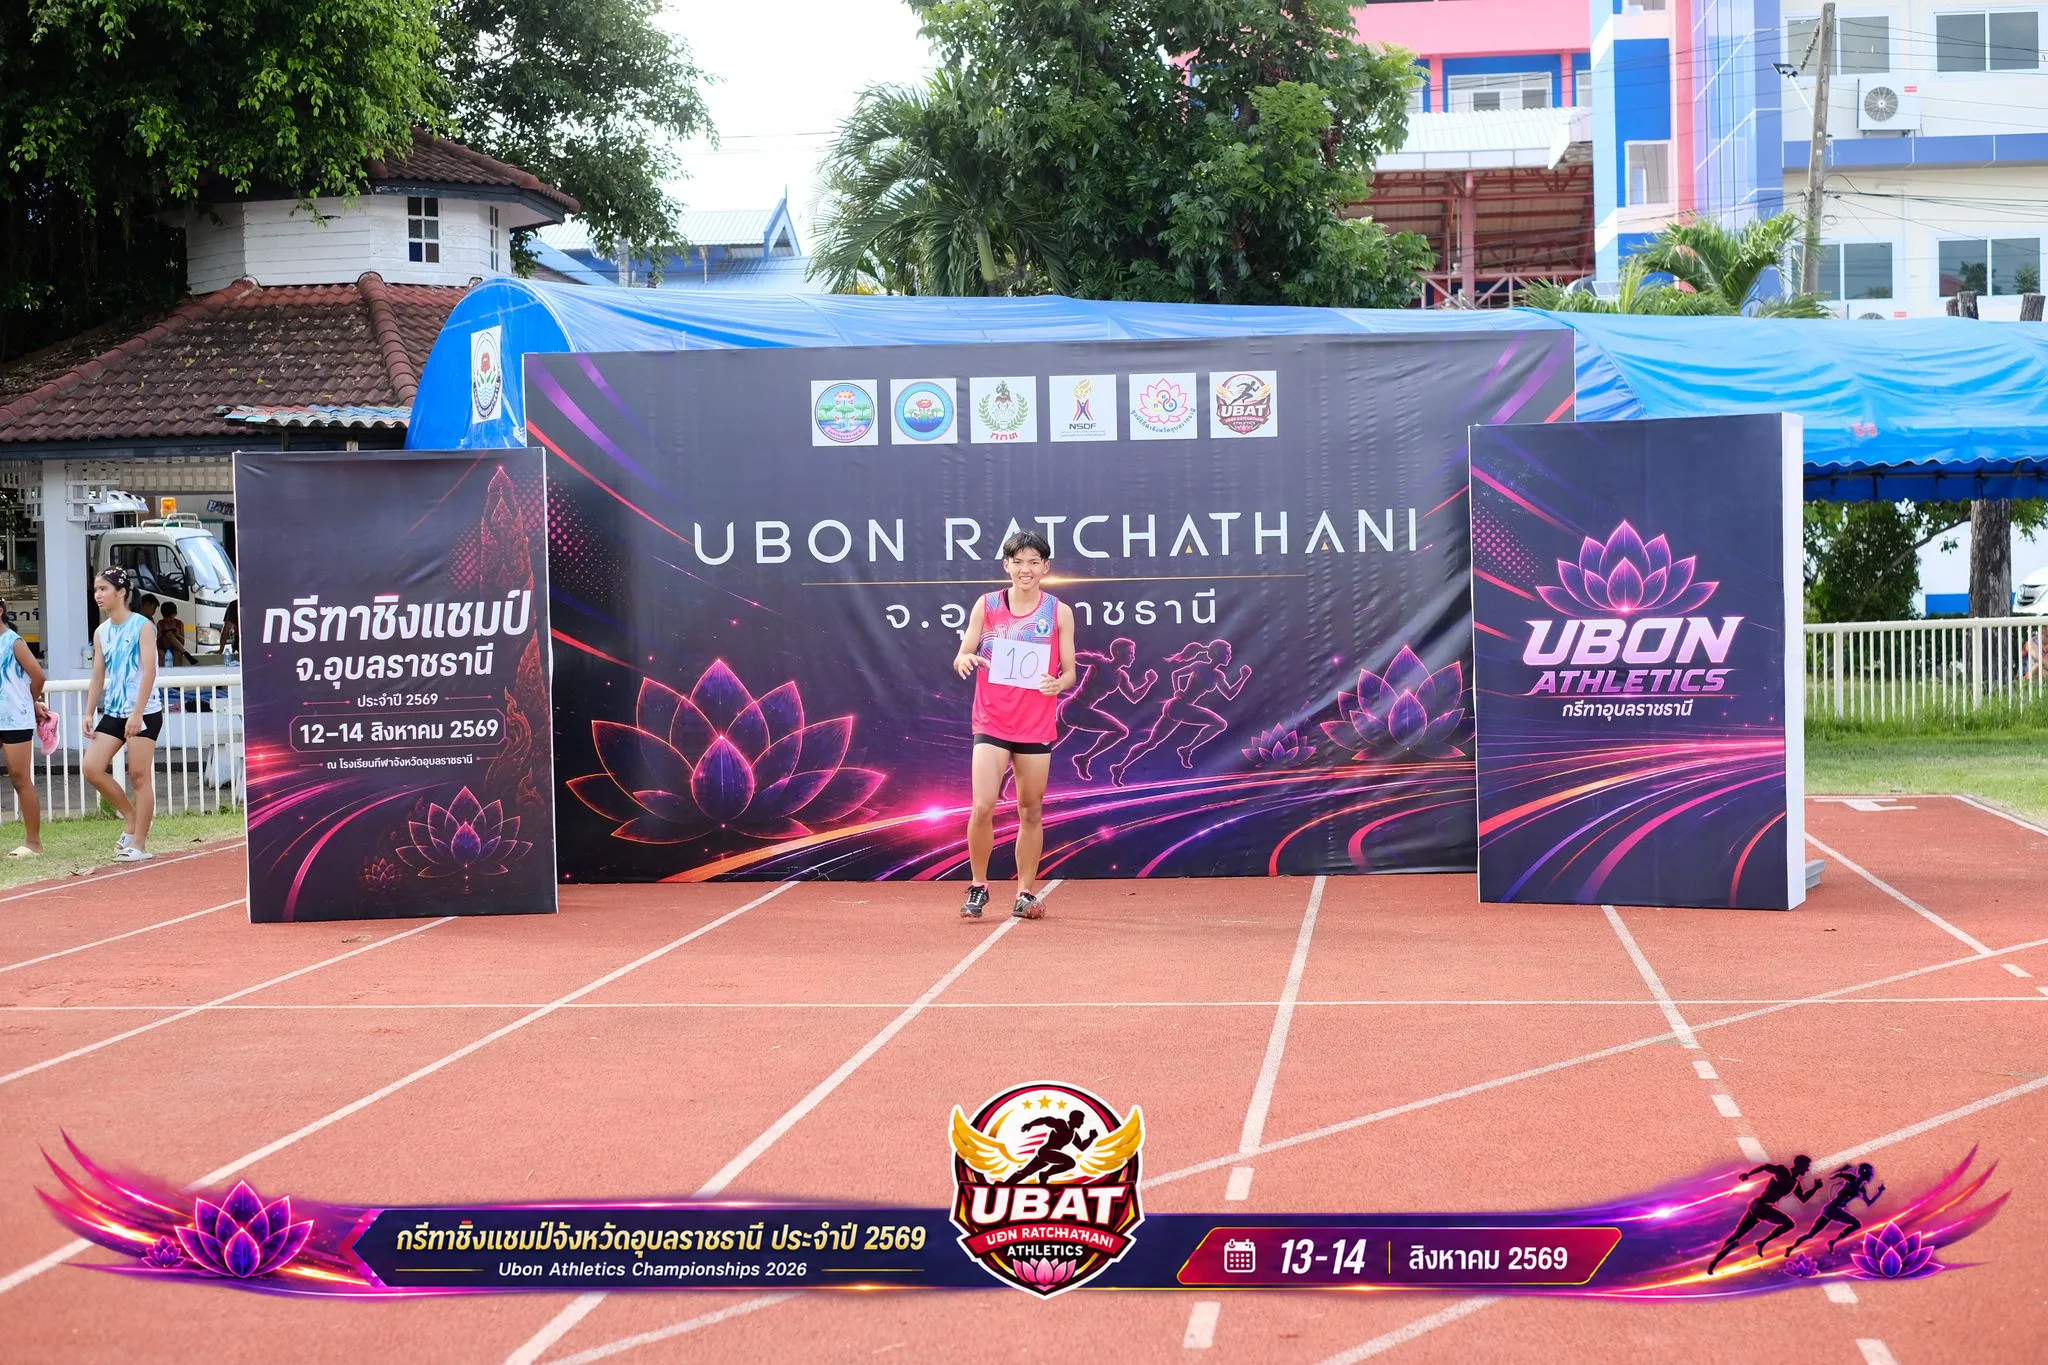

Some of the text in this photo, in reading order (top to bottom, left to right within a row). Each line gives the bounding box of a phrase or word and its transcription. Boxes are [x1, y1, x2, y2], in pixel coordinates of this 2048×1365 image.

[1221, 405, 1267, 417] UBAT
[694, 518, 904, 566] UBON
[262, 589, 532, 644] กรีฑาชิงแชมป์
[1523, 616, 1745, 666] UBON
[296, 642, 494, 690] จ.อุบลราชธานี
[1003, 647, 1040, 680] 10
[1522, 668, 1733, 695] ATHLETICS
[357, 693, 439, 708] ประจำปี 2569
[1562, 698, 1694, 721] กรีฑาอุบลราชธานี
[370, 721, 443, 742] สิงหาคม
[450, 719, 499, 739] 2569
[326, 754, 473, 770] ณ โรงเรียนกีฬาจังหวัดอุบลราชธานี
